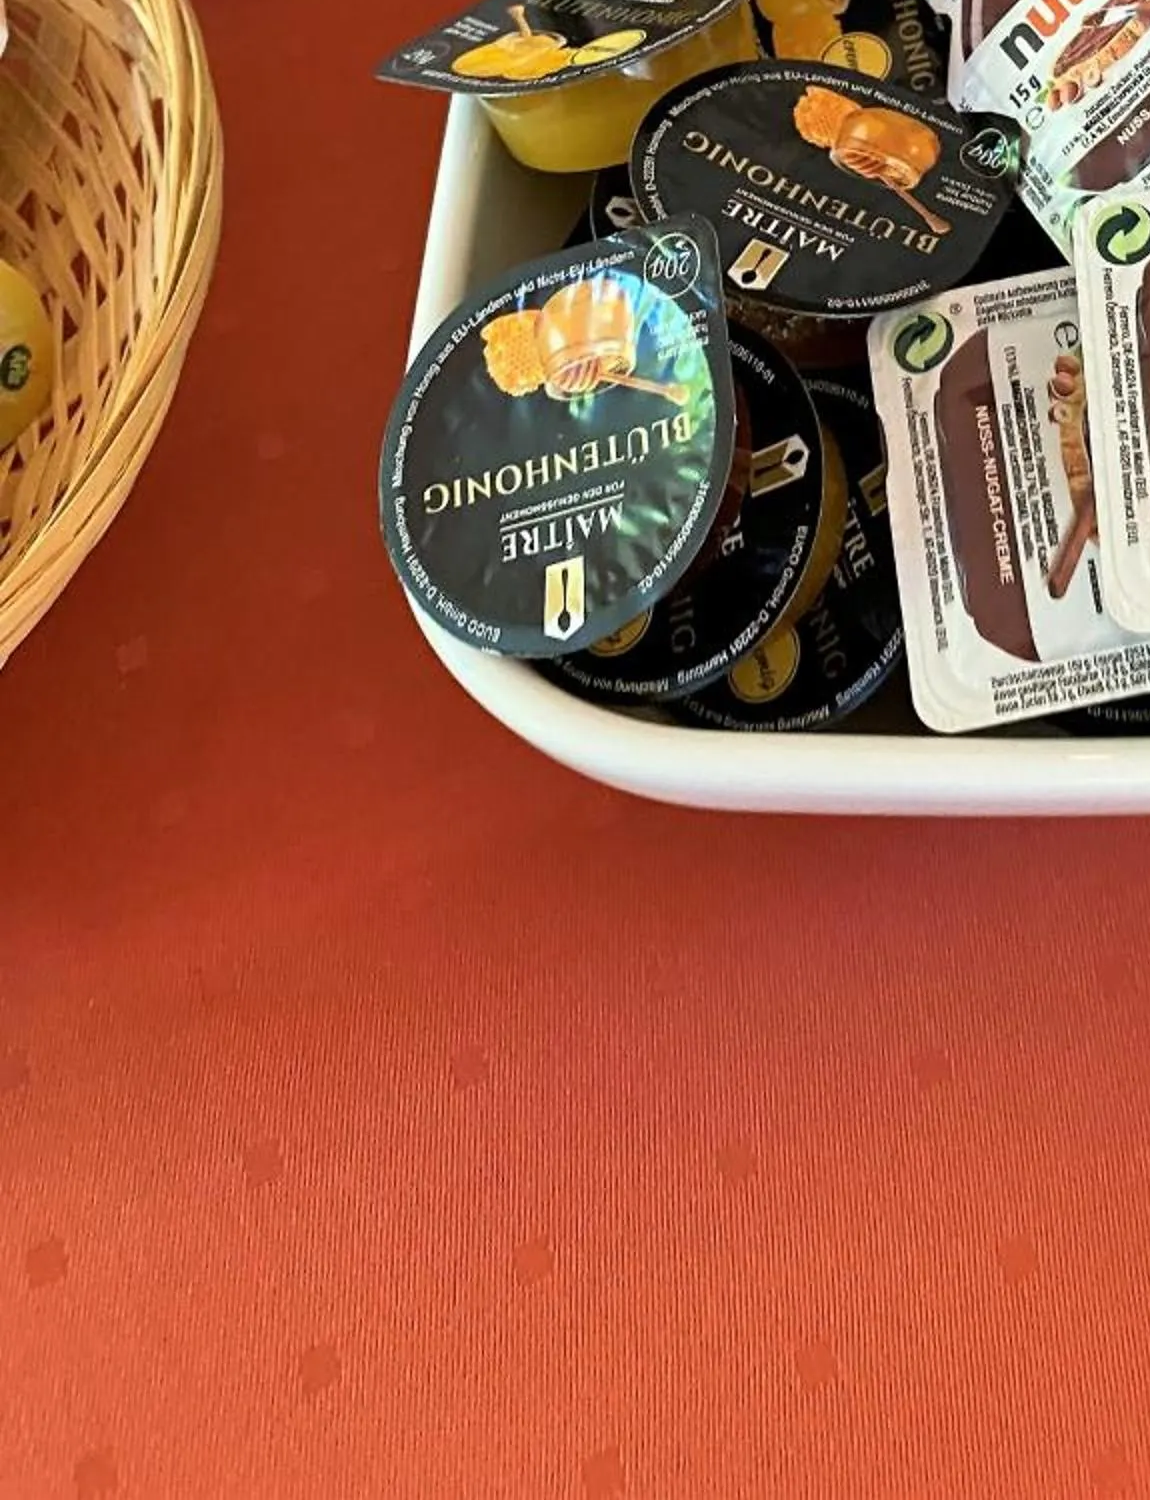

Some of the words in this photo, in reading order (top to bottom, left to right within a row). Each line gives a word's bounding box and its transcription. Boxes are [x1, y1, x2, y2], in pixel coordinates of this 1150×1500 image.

[682, 131, 941, 255] BLÜTENHONIG
[721, 199, 845, 262] MAÎTRE
[650, 252, 691, 279] 20g
[414, 363, 441, 399] Honig
[451, 292, 513, 343] EU-Ländern
[423, 411, 693, 514] BLÜTENHONIG
[500, 493, 581, 521] GENUSSMOMENT
[582, 486, 602, 499] DEN
[604, 479, 625, 494] FÜR
[969, 405, 1017, 586] NUSS-NUGAT-CREME
[393, 496, 413, 554] Hamburg
[501, 501, 624, 563] MAÎTRE
[406, 553, 438, 600] D-22291
[436, 593, 467, 628] GmbH,
[467, 619, 500, 643] EUCO
[677, 647, 729, 685] Hamburg
